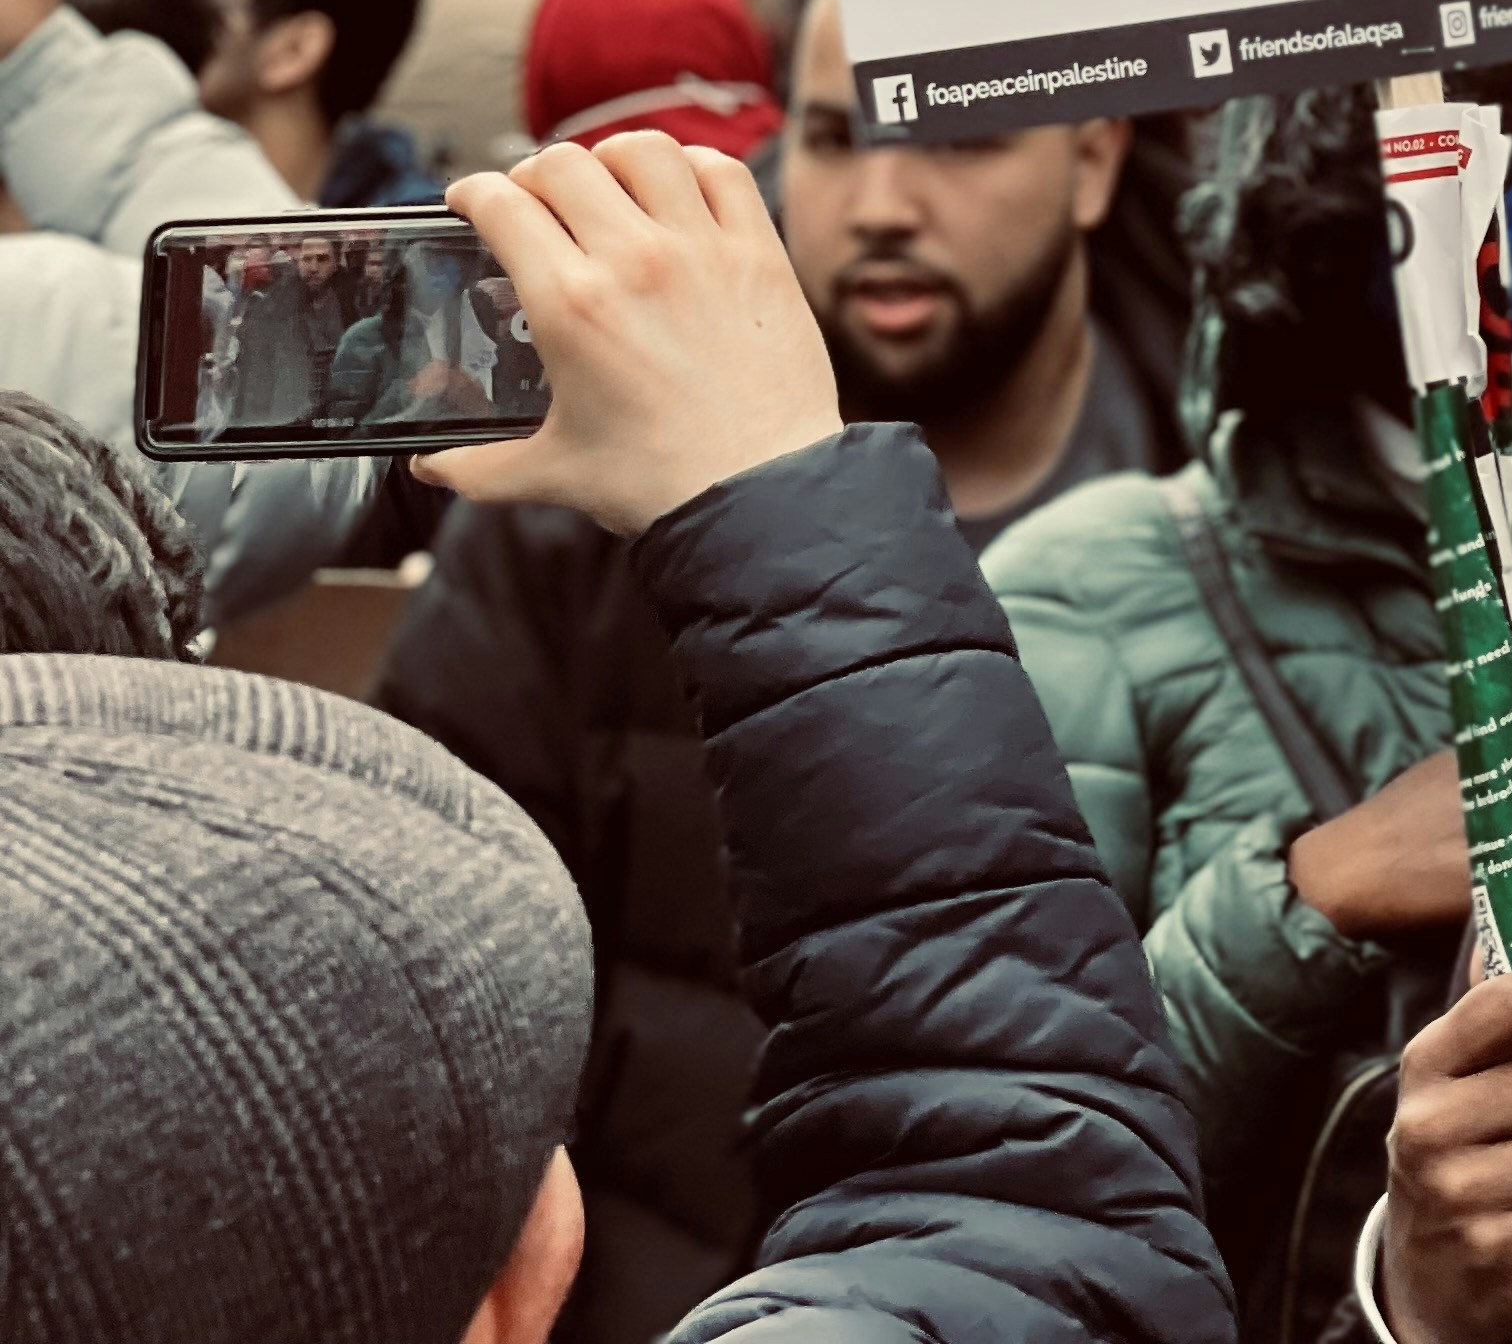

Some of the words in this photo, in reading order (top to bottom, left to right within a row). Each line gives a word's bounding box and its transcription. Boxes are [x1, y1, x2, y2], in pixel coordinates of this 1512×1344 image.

[1238, 22, 1404, 62] friendsofalaqsa
[926, 57, 1148, 108] foapeaceinpalestine
[1393, 138, 1426, 153] NO.02
[1477, 639, 1511, 666] need
